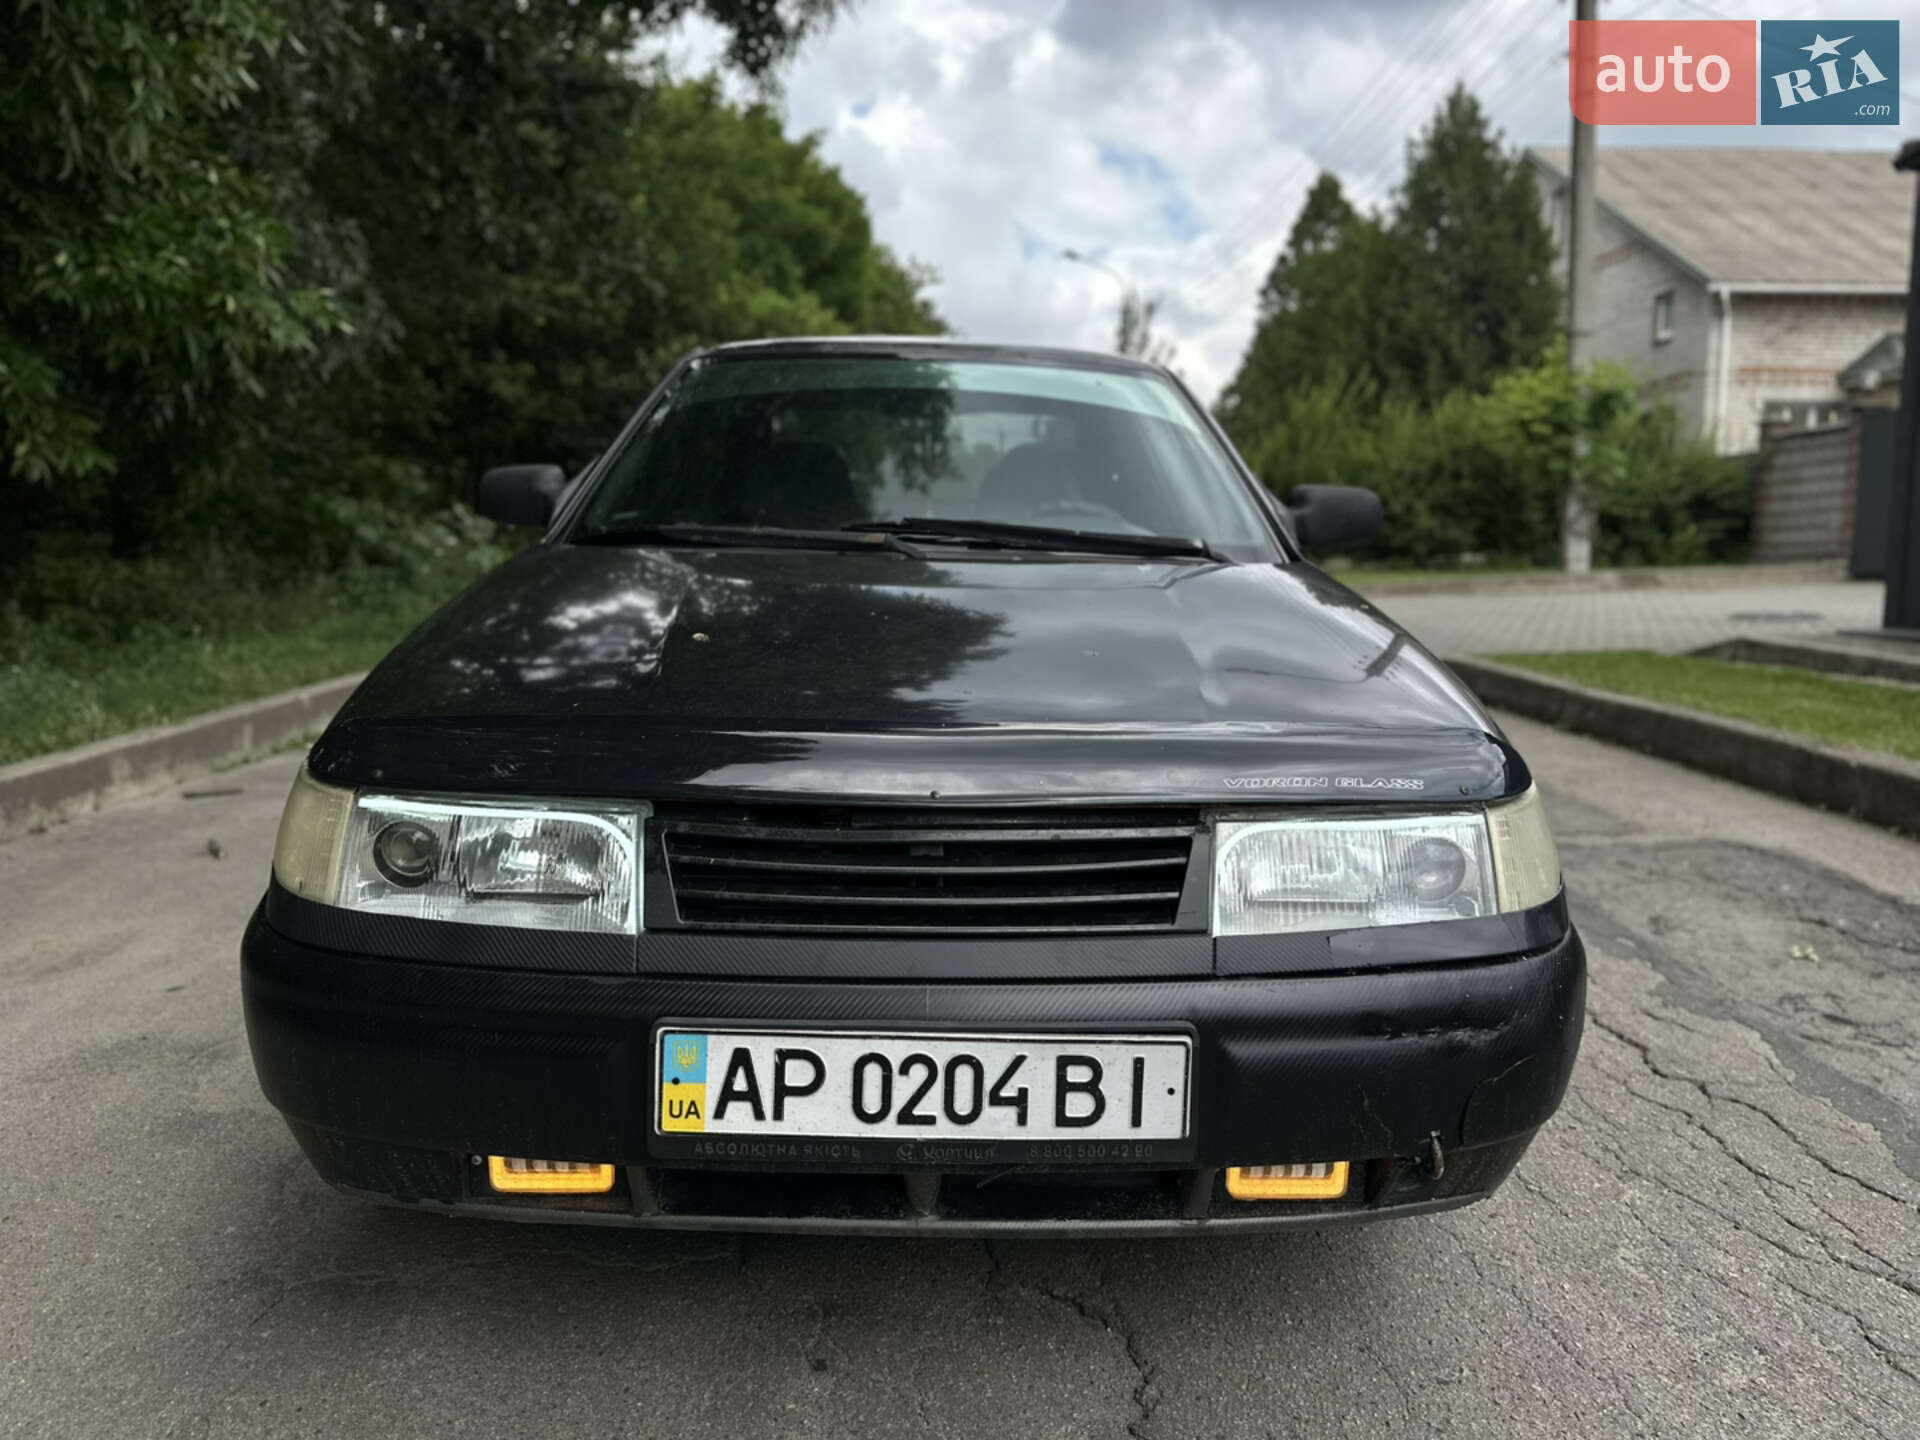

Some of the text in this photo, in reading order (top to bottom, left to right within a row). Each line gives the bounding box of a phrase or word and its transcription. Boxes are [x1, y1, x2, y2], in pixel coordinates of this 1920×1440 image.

[1223, 776, 1424, 790] VORON GLASS
[712, 1047, 1145, 1128] AP 0204 BI
[668, 1100, 701, 1120] UA
